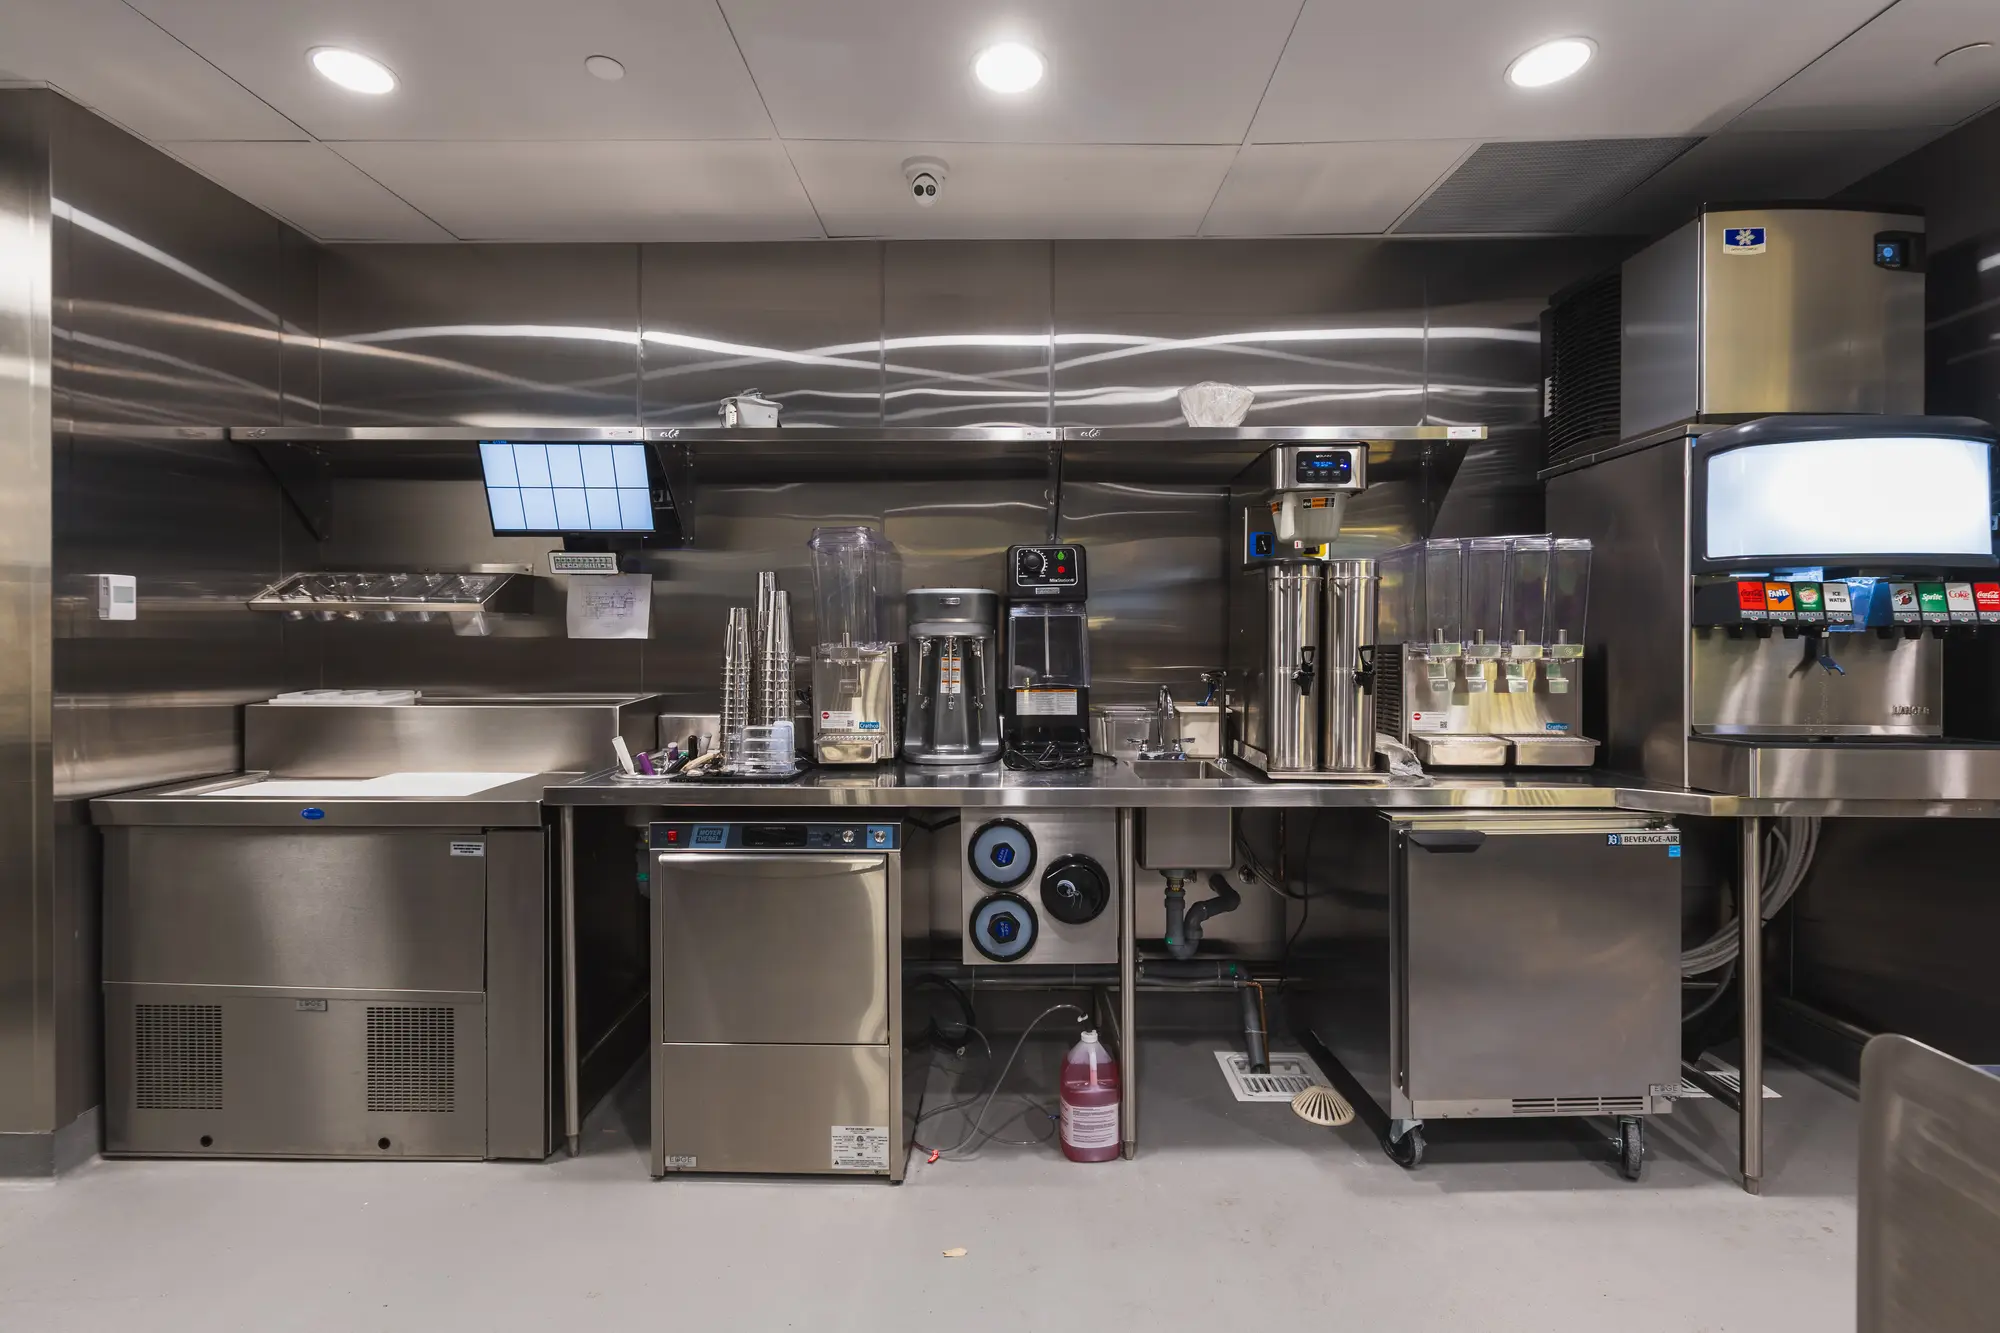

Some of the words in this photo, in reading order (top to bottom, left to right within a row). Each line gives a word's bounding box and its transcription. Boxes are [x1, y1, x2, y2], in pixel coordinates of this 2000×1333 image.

[1768, 589, 1790, 598] FANTA
[1921, 593, 1943, 601] Sprite
[1948, 590, 1970, 599] Coke
[1624, 835, 1679, 843] BEVERAGE-AIR
